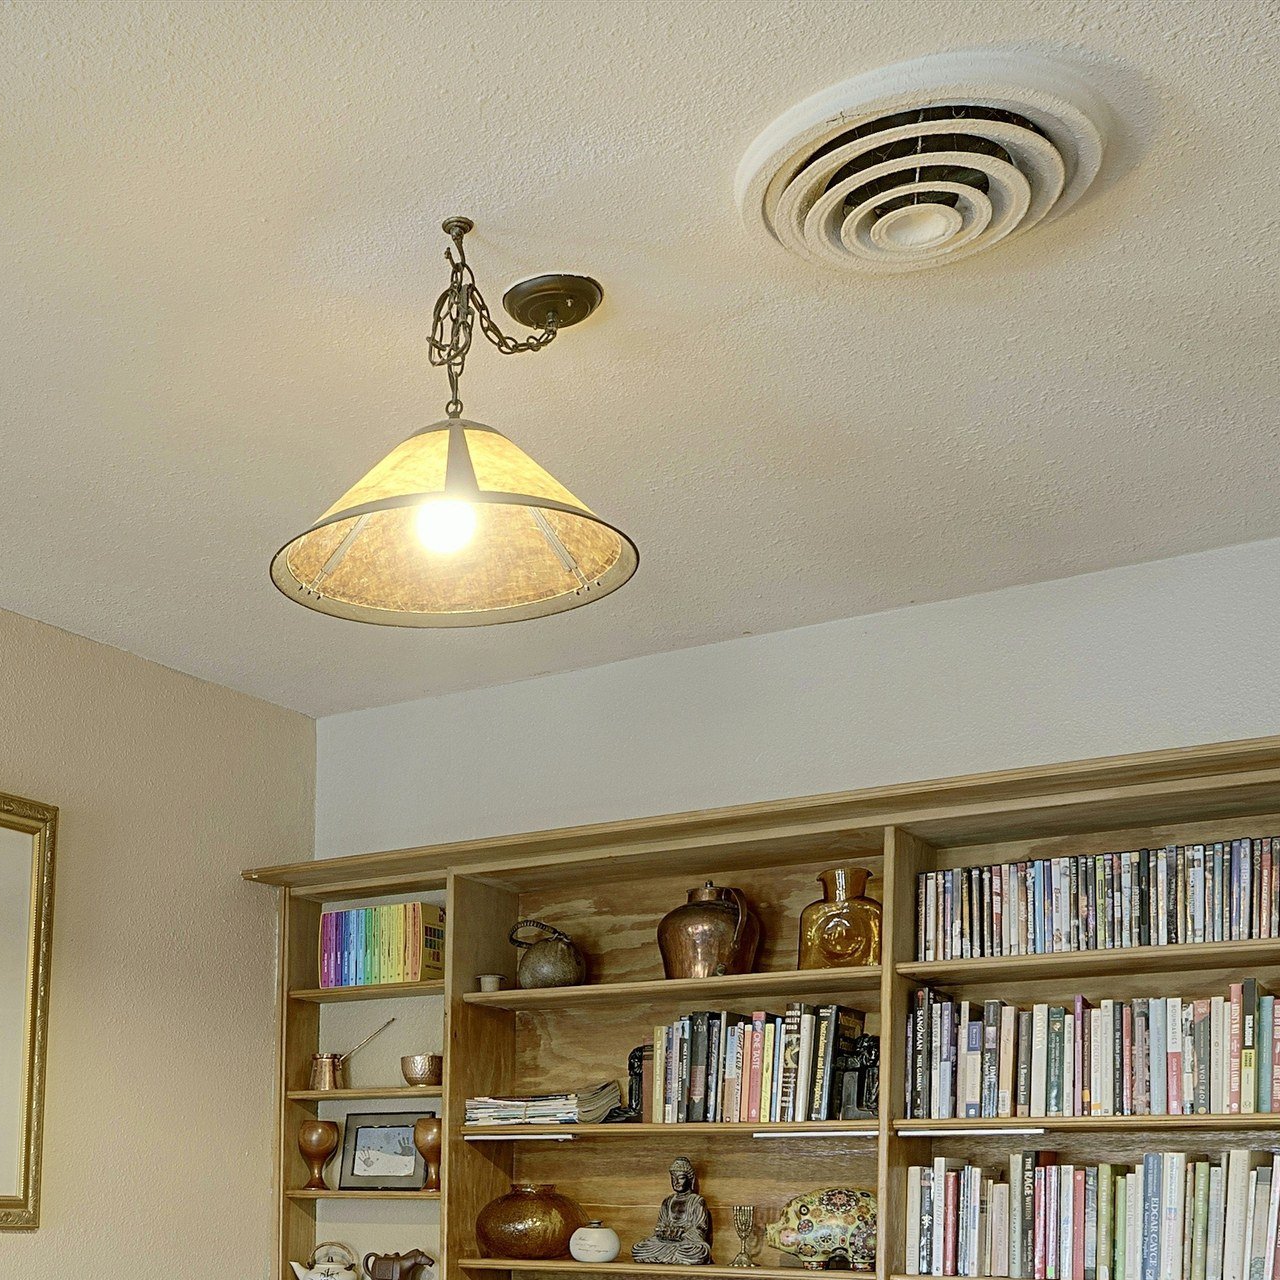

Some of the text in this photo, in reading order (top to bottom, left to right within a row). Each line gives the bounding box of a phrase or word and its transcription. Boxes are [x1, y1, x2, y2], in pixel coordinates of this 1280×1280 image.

[1253, 844, 1261, 871] TROY
[736, 1027, 744, 1050] FIGHT
[818, 1020, 828, 1057] Nostradamus
[916, 1009, 926, 1051] SANDMAN
[735, 1051, 743, 1071] CLUB
[752, 1049, 761, 1070] TASTE
[817, 1056, 826, 1068] and
[814, 1079, 825, 1109] Prophecies
[1024, 1170, 1034, 1196] RAGE
[1149, 1197, 1159, 1267] EDGAR CAYCE
